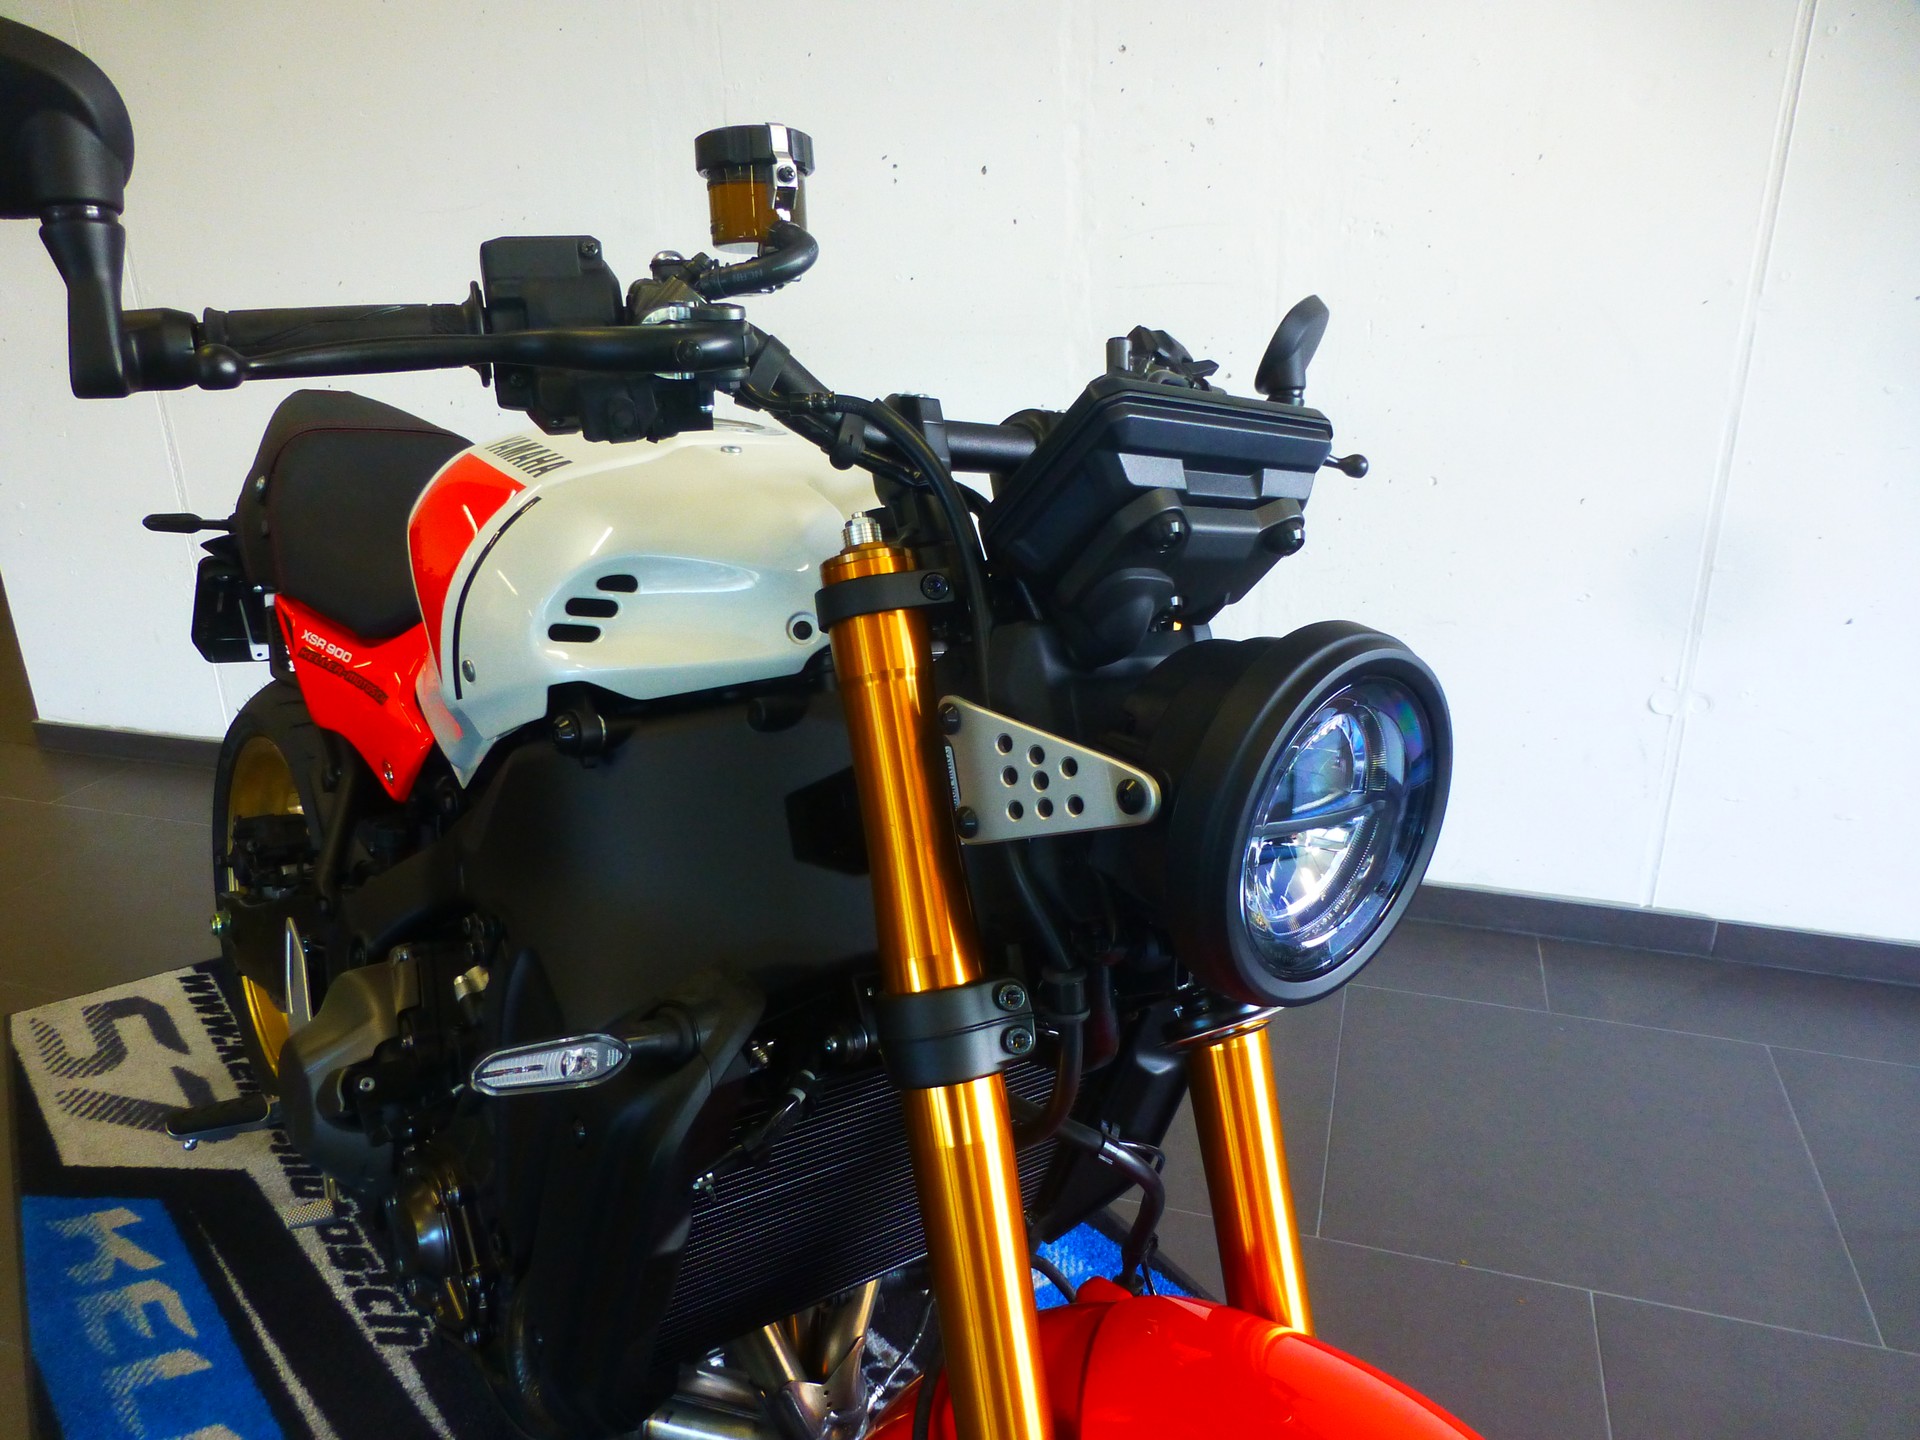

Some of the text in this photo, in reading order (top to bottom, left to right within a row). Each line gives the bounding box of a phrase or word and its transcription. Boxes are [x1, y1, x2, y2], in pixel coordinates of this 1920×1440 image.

[485, 435, 573, 478] YAMAHA
[301, 629, 353, 663] XSR 900
[46, 1207, 248, 1440] KEL
